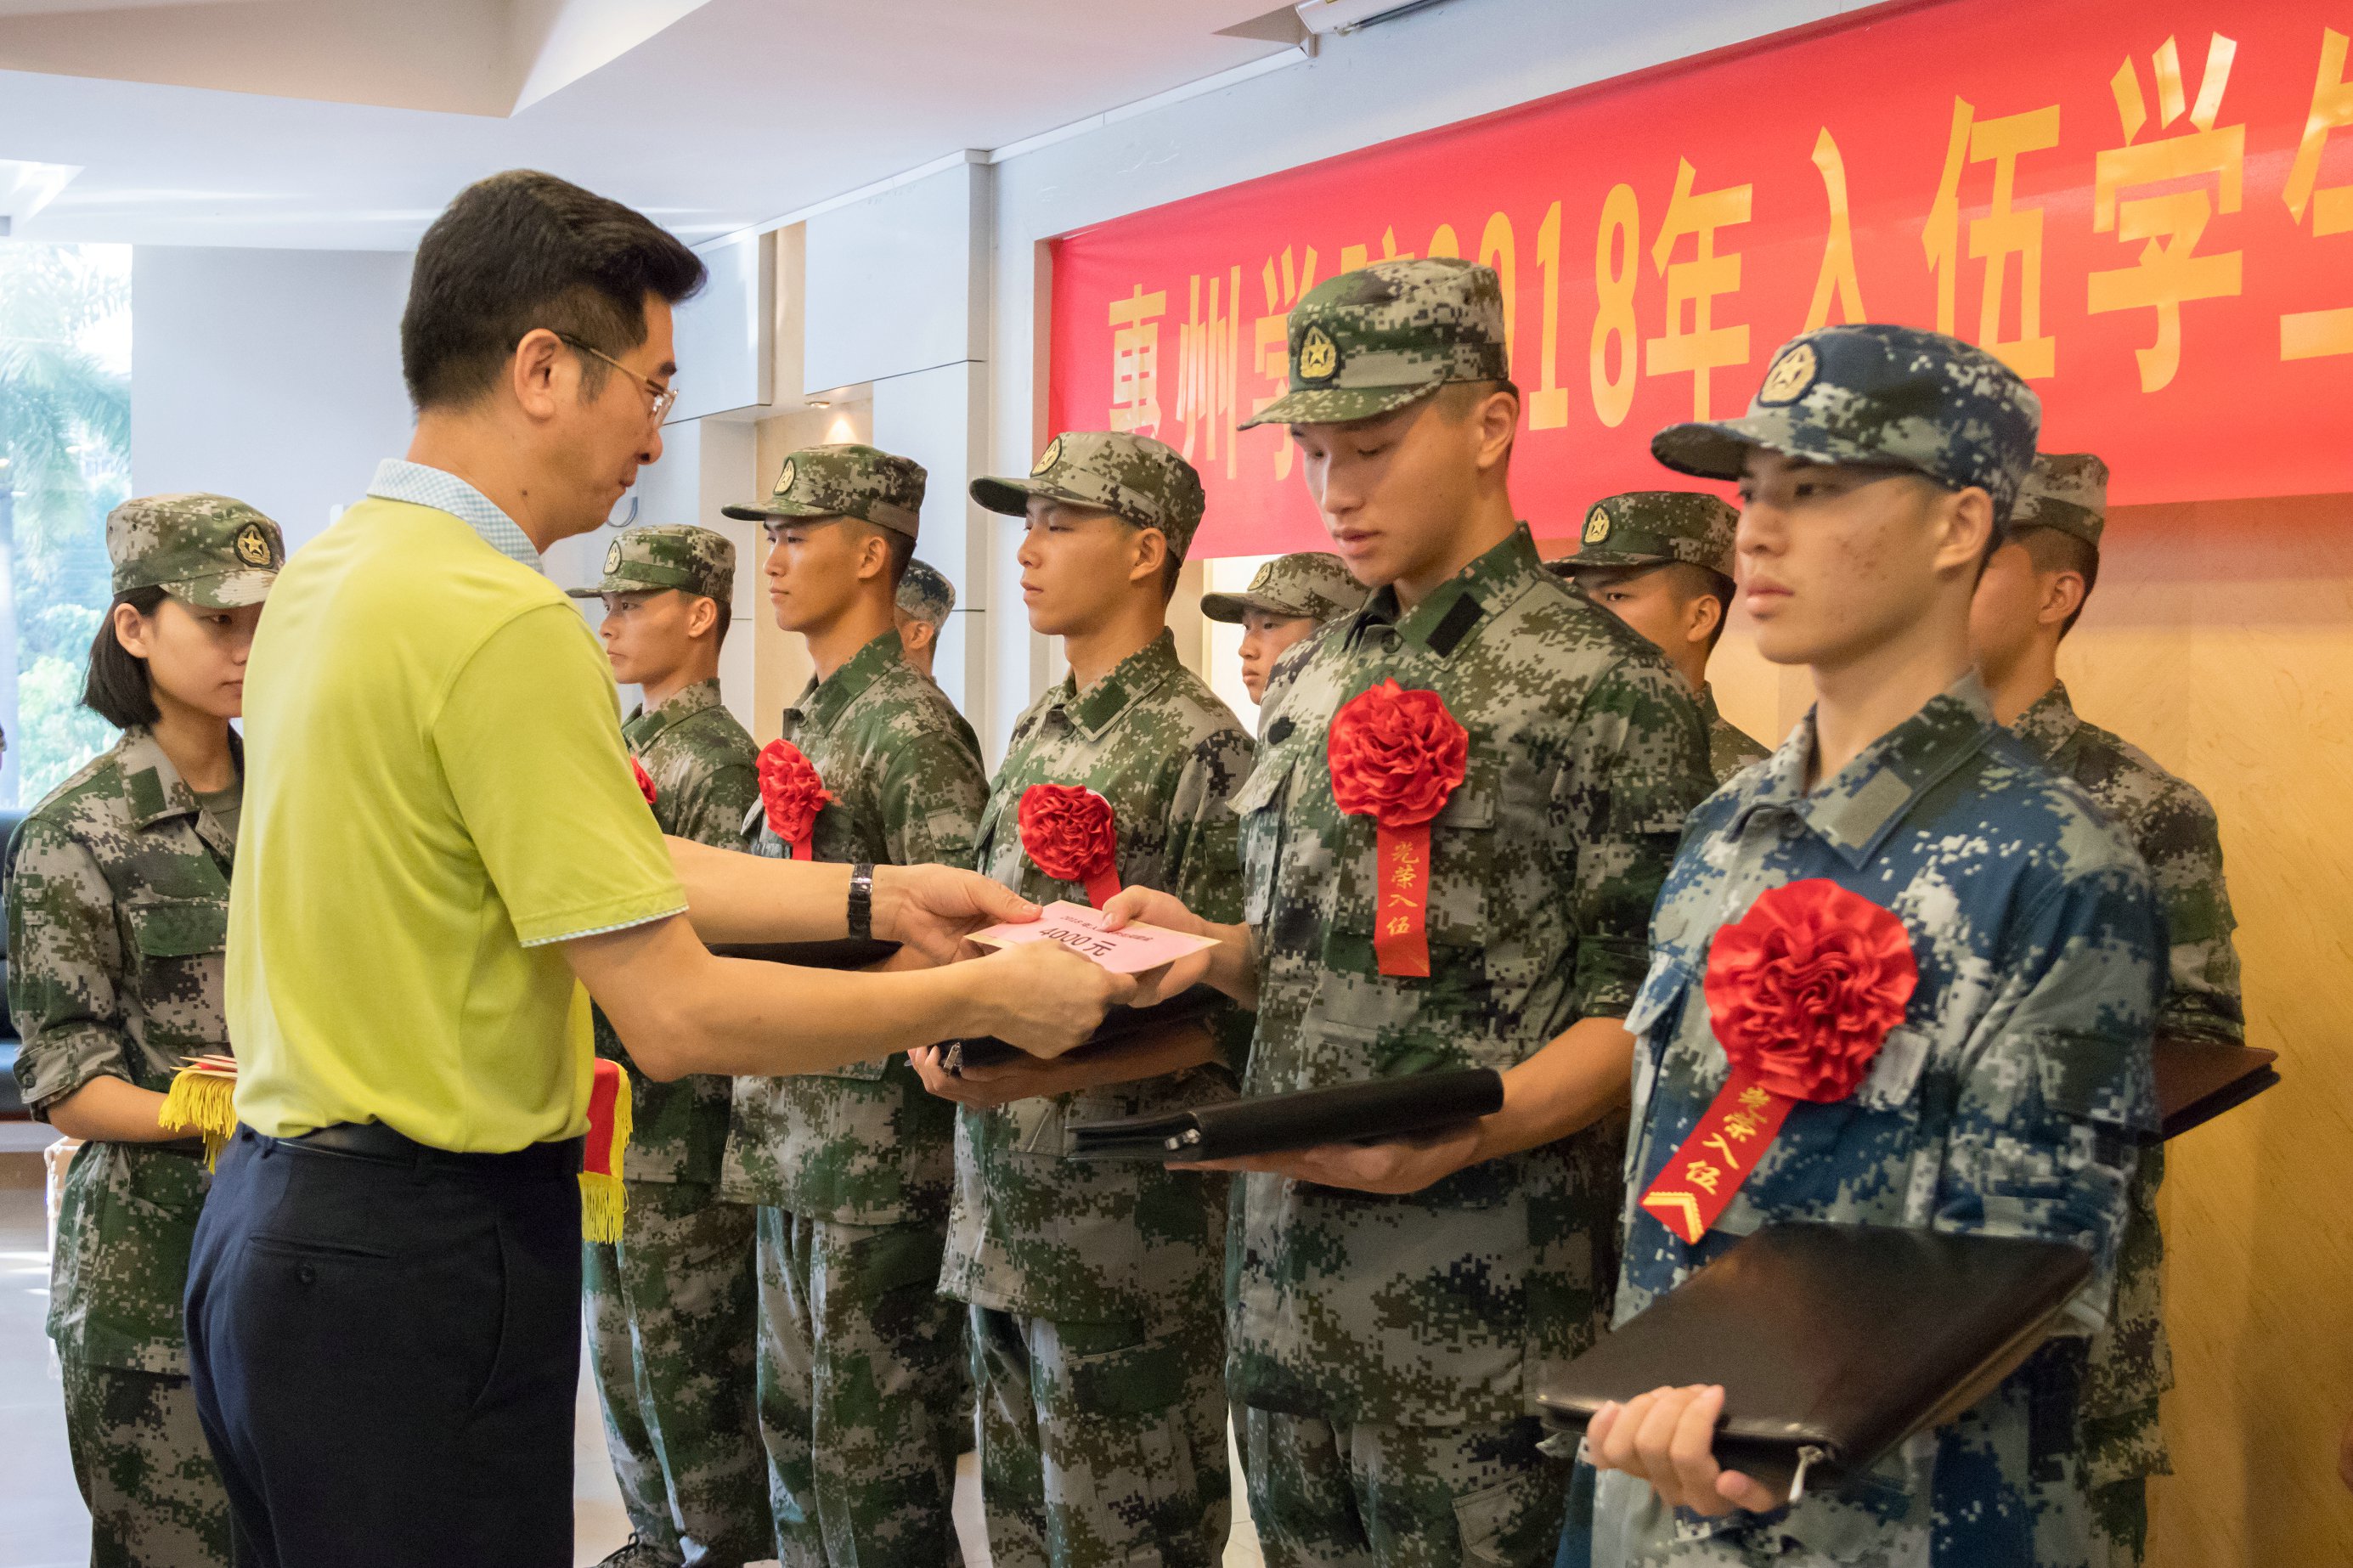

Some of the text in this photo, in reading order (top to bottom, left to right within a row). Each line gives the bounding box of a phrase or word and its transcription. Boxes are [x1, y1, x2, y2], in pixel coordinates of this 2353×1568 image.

[1386, 841, 1419, 936] 光荣入伍
[1685, 1087, 1771, 1195] 光荣入伍
